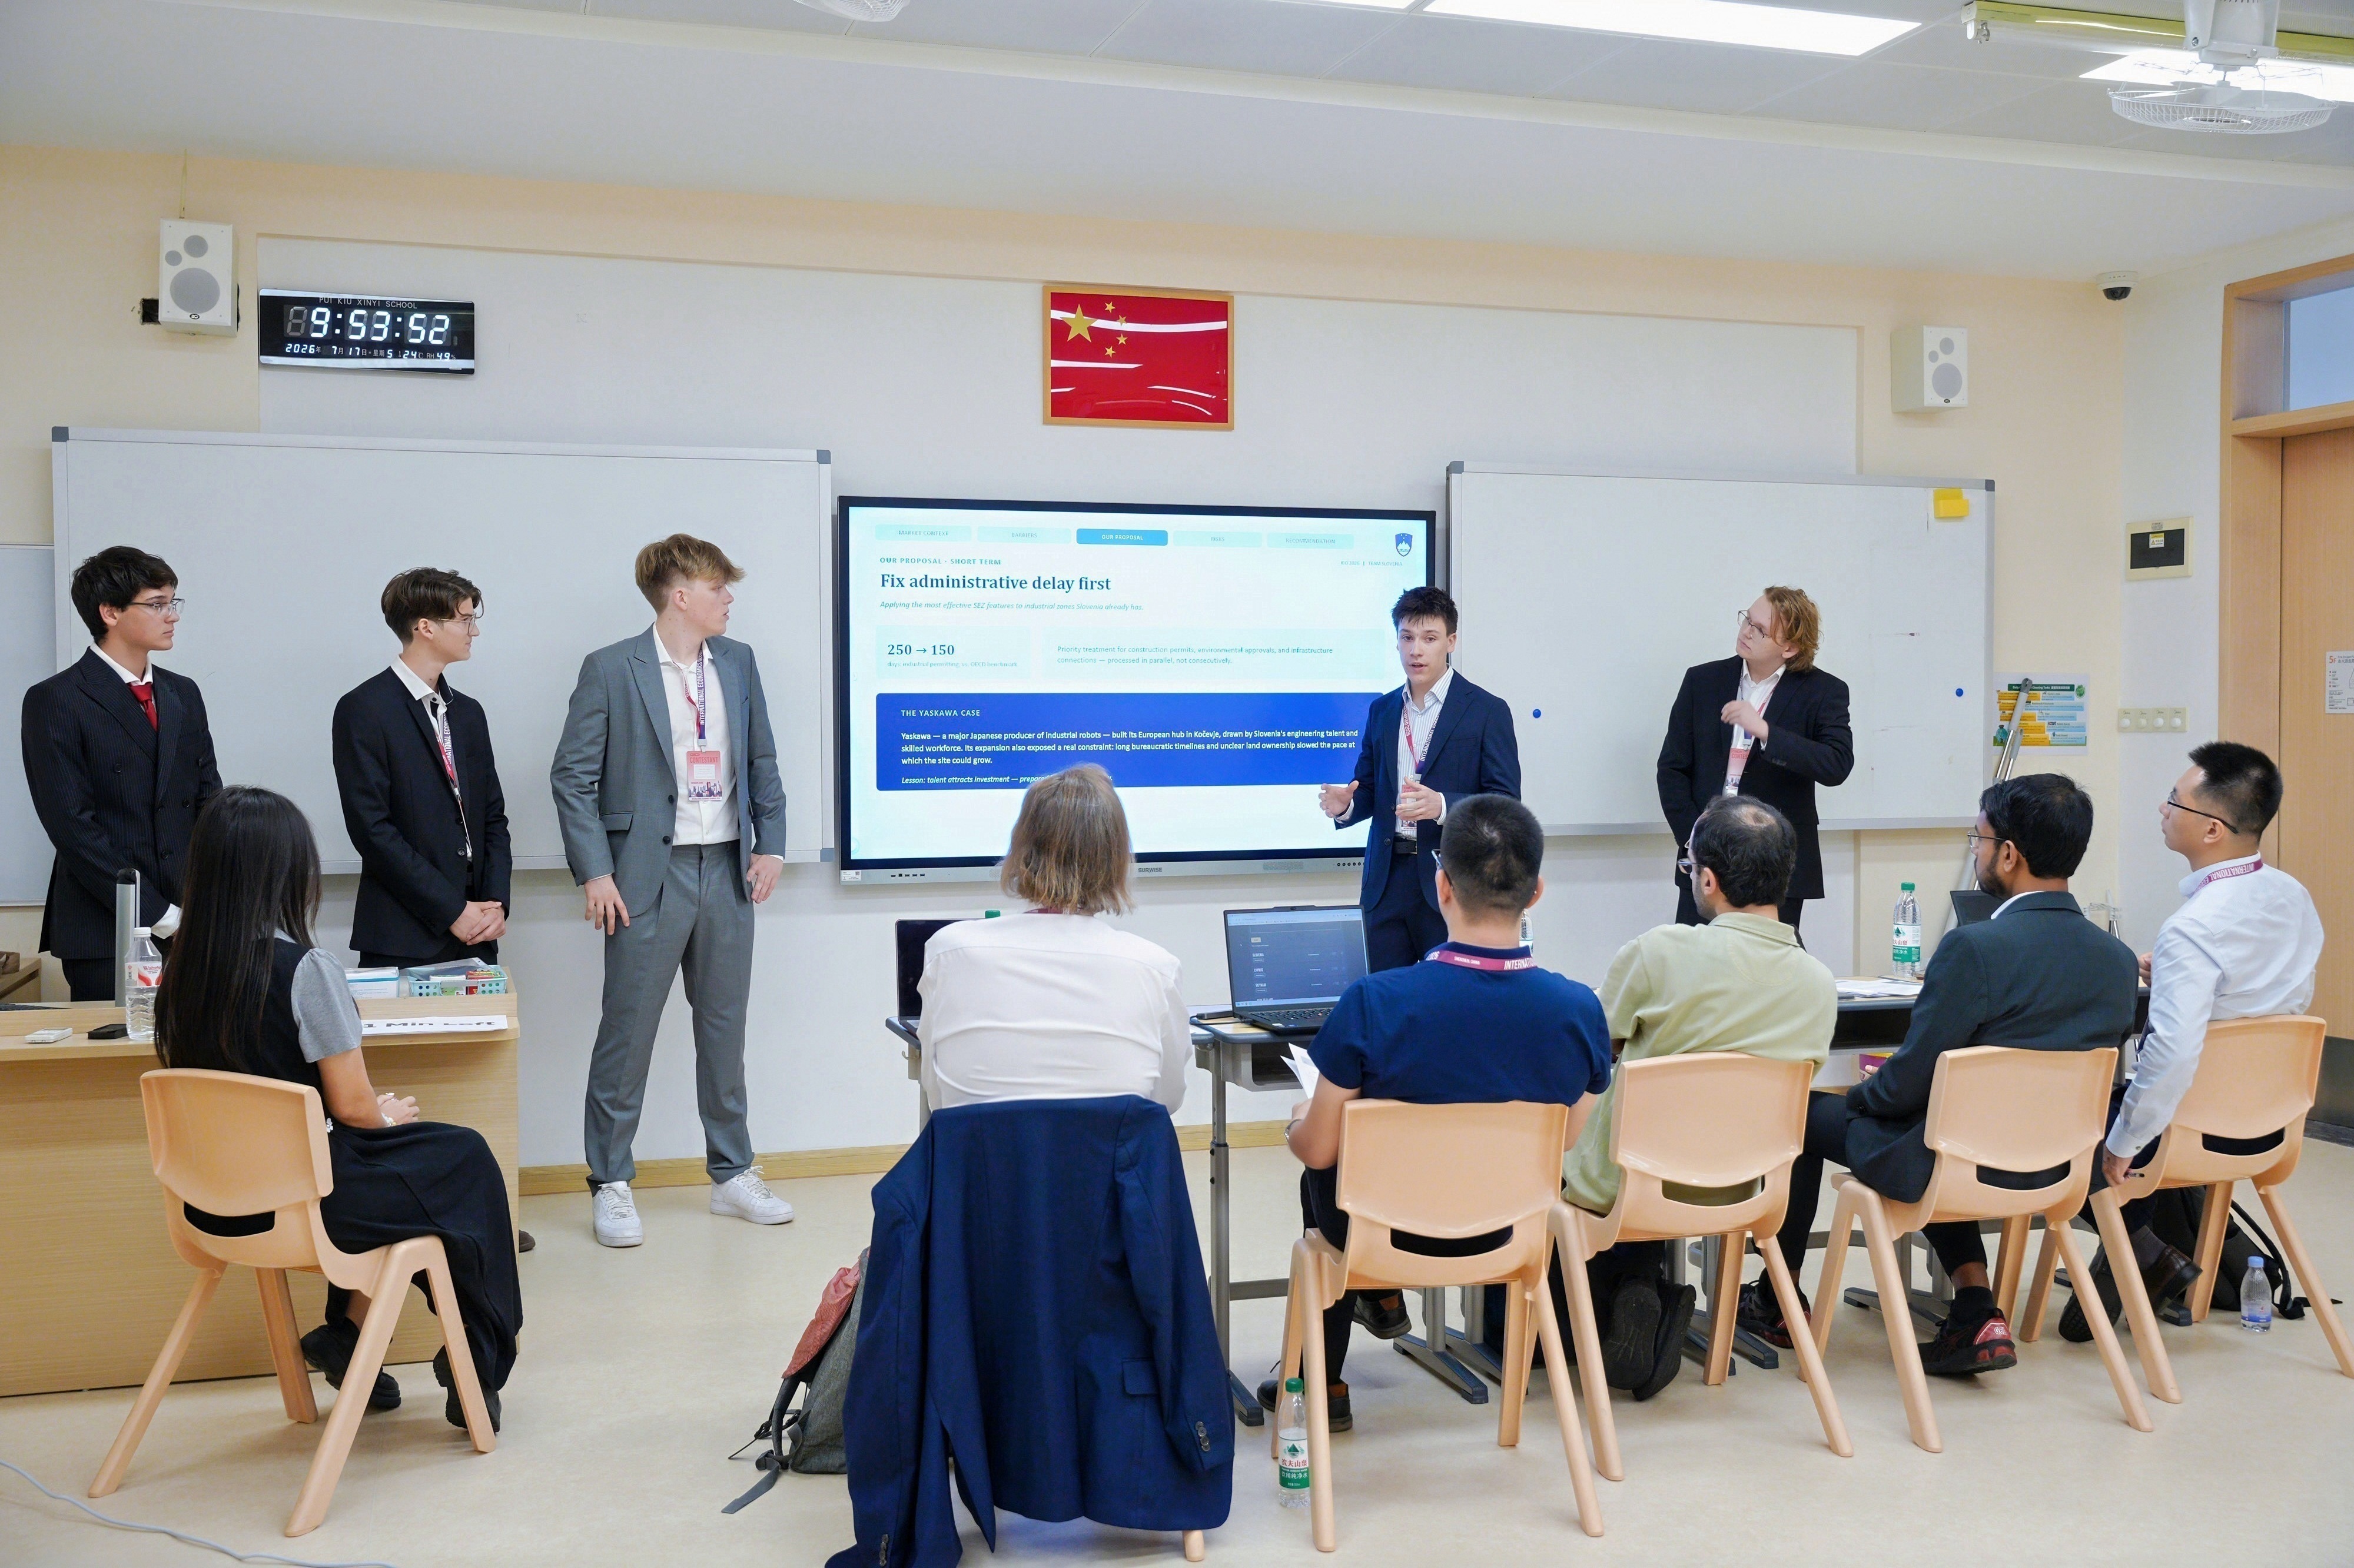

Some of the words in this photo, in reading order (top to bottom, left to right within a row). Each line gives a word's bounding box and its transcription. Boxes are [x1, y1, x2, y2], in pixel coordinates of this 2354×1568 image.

[386, 301, 417, 309] SCHOOL
[881, 574, 905, 588] Fix
[909, 574, 1028, 589] administrative
[1032, 576, 1075, 593] delay
[1079, 577, 1111, 590] first
[880, 601, 910, 609] Applying
[986, 602, 1014, 610] features
[887, 645, 912, 655] 250
[931, 645, 955, 655] 150
[948, 732, 970, 741] major
[970, 732, 1002, 740] Japanese
[1004, 732, 1035, 740] producer
[1138, 731, 1170, 739] European
[1194, 730, 1221, 739] Kočevje,
[1244, 730, 1253, 739] by
[1287, 730, 1325, 739] engineering
[975, 744, 1010, 752] expansion
[1027, 743, 1055, 752] exposed
[1115, 743, 1130, 752] long
[1261, 742, 1295, 750] ownership
[2209, 863, 2255, 881] INTERNATIONAL
[1281, 1458, 1307, 1467] 农夫山泉
